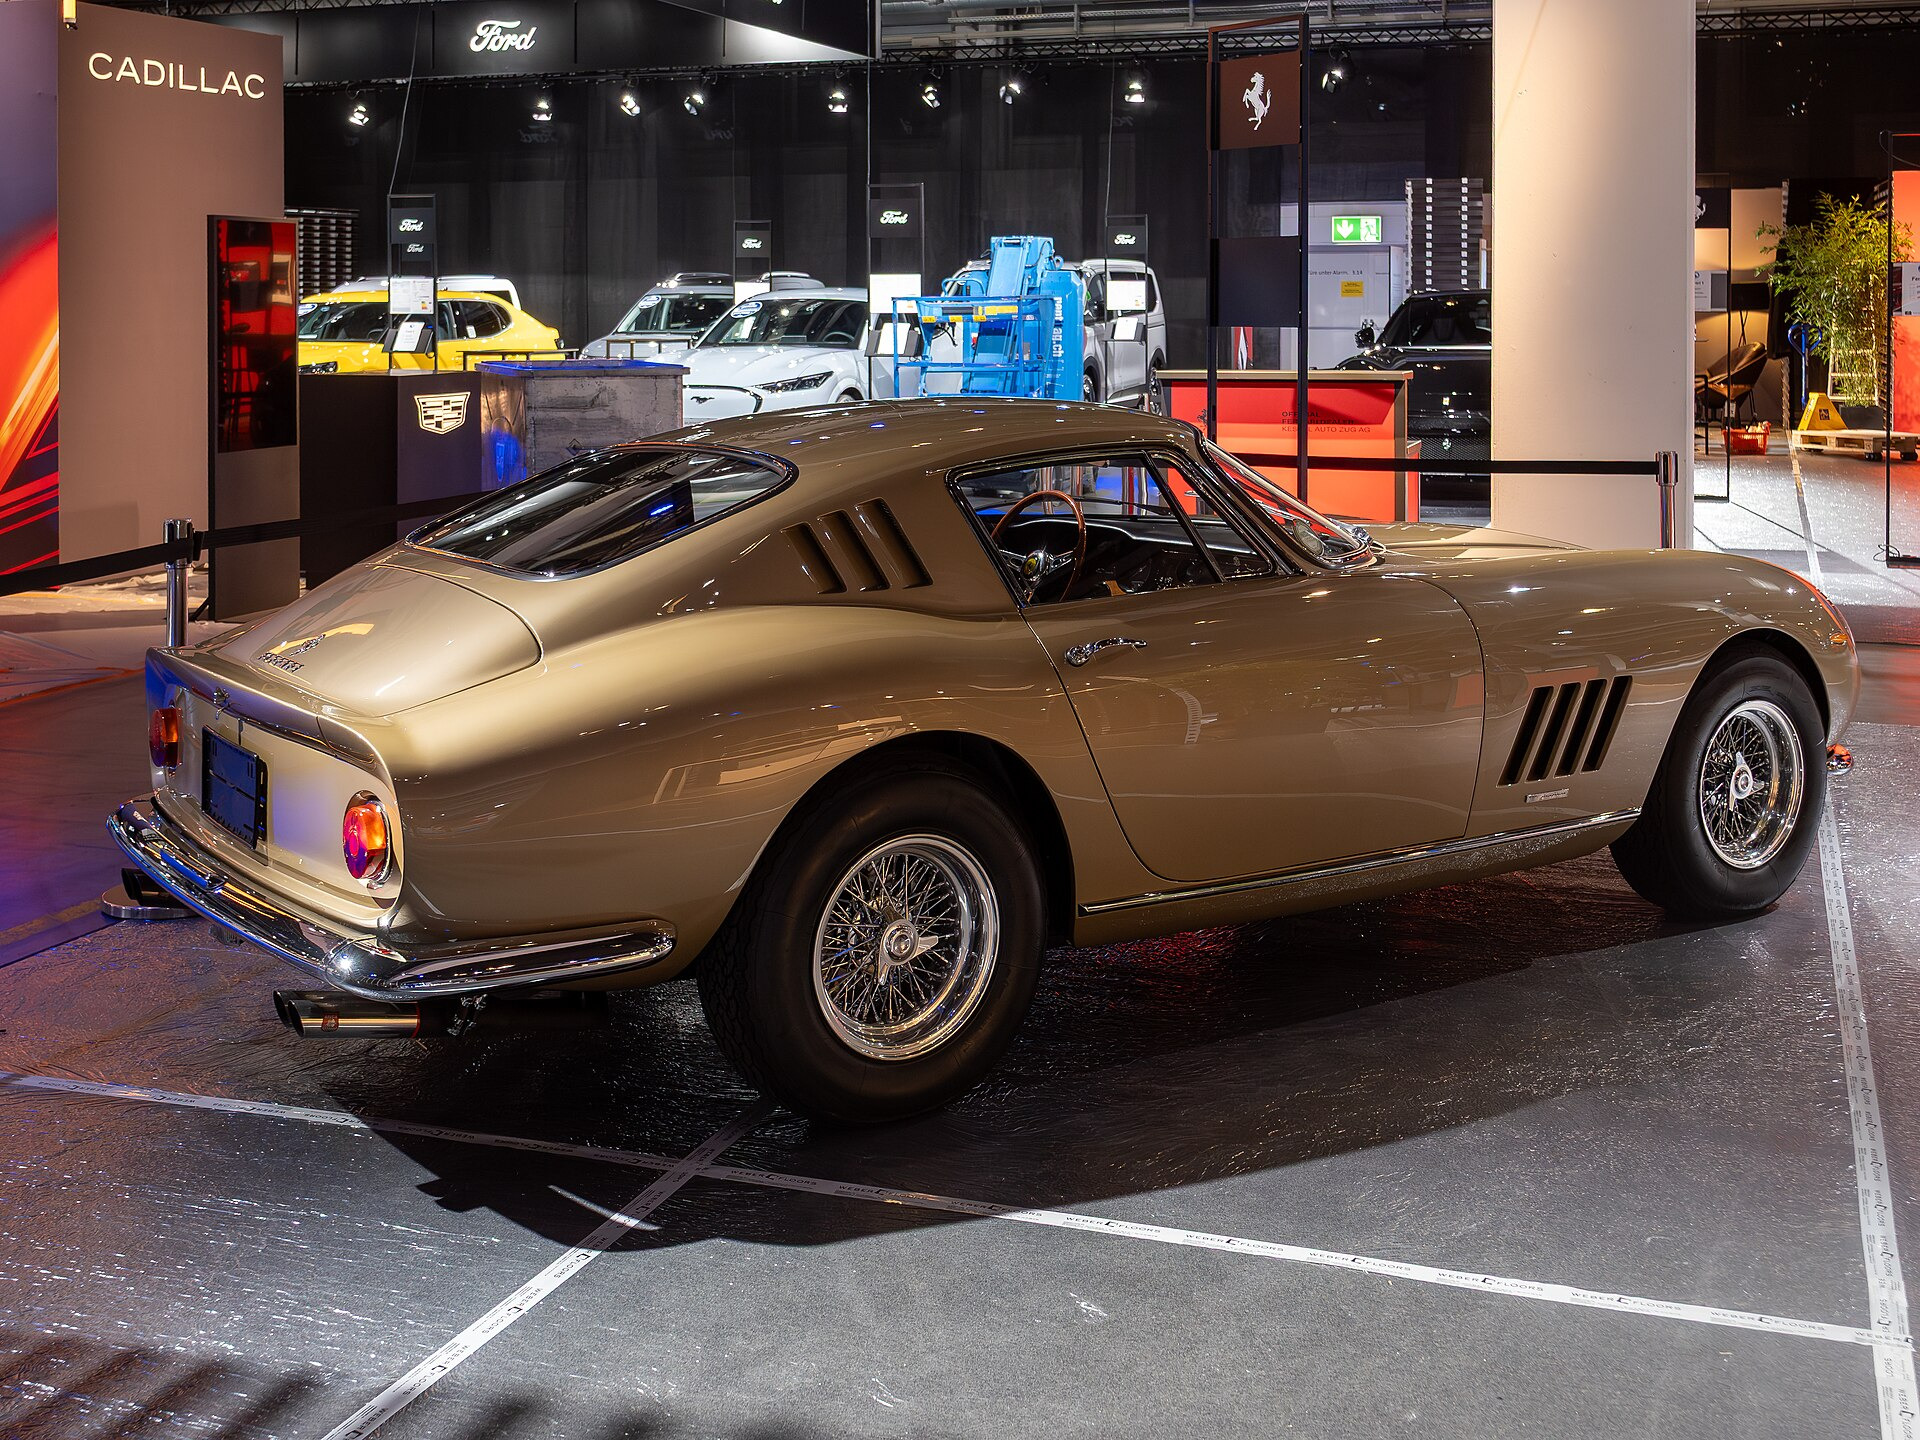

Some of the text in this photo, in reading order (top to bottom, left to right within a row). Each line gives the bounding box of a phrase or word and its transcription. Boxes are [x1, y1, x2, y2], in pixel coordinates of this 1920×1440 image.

[470, 20, 537, 52] Ford
[88, 52, 264, 98] CADILLAC
[880, 211, 908, 224] Ford
[400, 219, 424, 232] Ford
[742, 238, 762, 249] Ford
[1114, 234, 1136, 244] Ford
[406, 244, 424, 252] Ford
[1066, 1216, 1102, 1225] WEBER
[1185, 1233, 1283, 1251] WEBER FLOORS
[554, 1259, 579, 1280] FLOORS
[1496, 1280, 1543, 1291] FLOORS
[404, 1372, 434, 1397] FLOORS
[359, 1407, 387, 1431] WEBER
[1902, 1418, 1912, 1440] FLOOR
